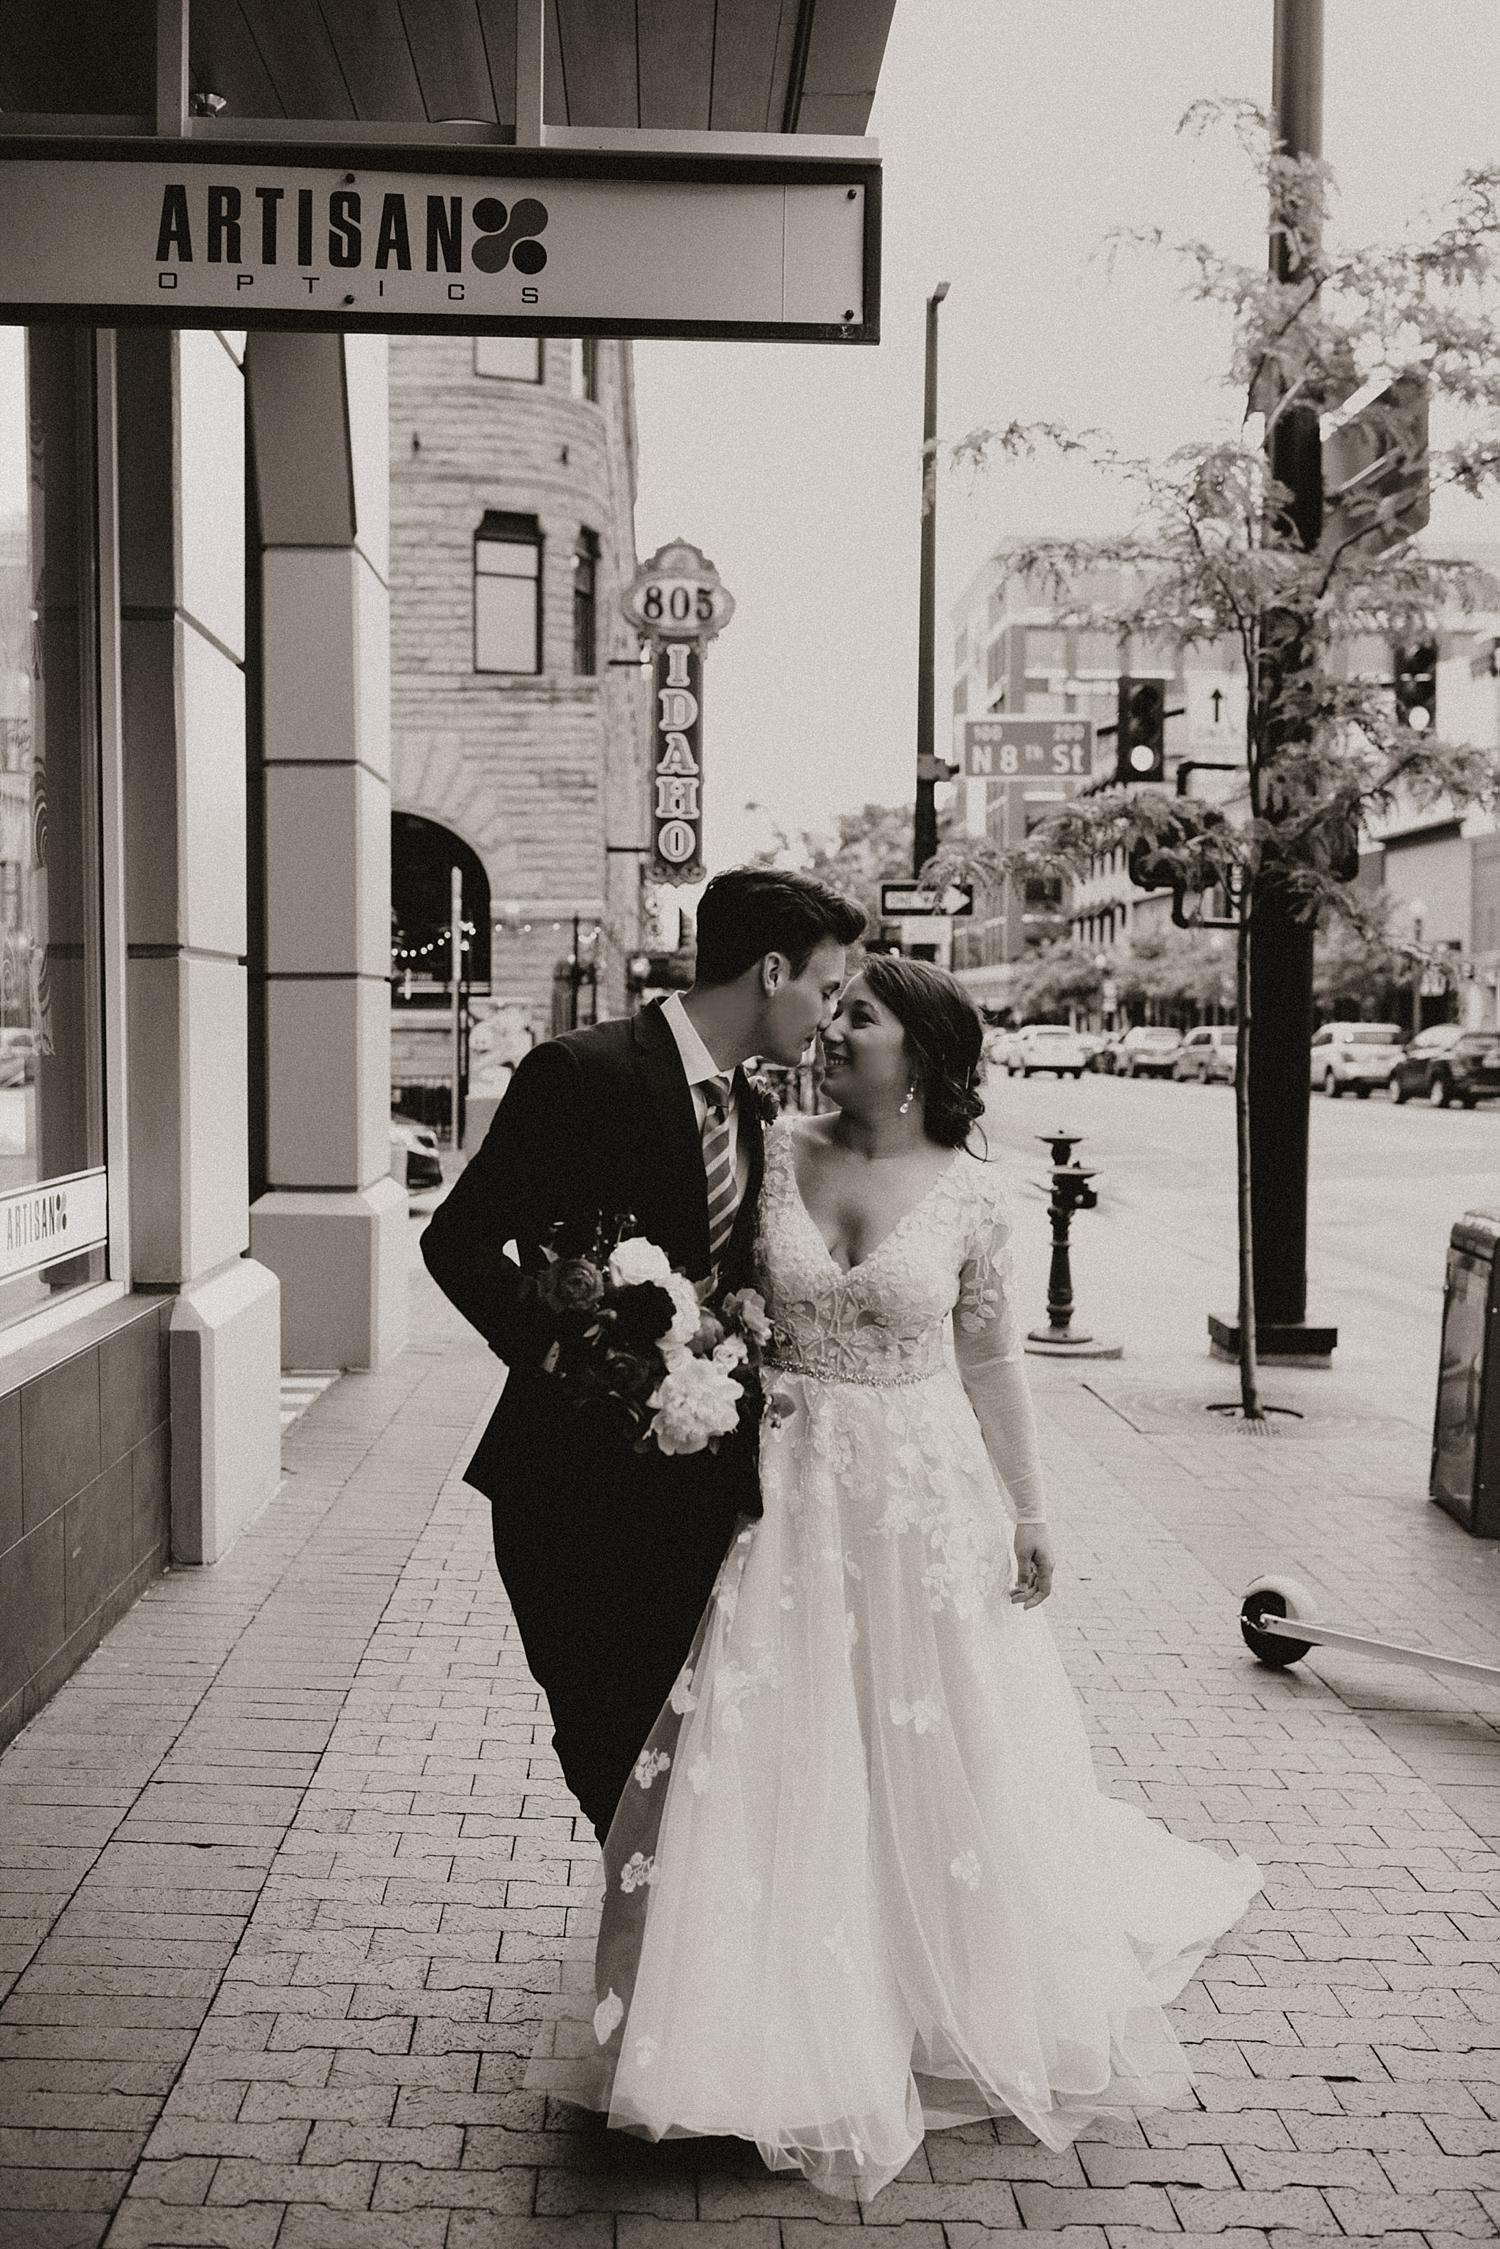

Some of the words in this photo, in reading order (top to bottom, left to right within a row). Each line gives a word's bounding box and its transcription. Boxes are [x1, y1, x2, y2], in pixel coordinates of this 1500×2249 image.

[156, 184, 463, 274] ARTISAN
[158, 272, 539, 304] OPTICS
[643, 586, 714, 621] 805
[655, 643, 700, 863] IDAHO
[971, 744, 993, 774] N
[1052, 743, 1084, 774] St
[7, 1195, 55, 1250] ARTISAN
